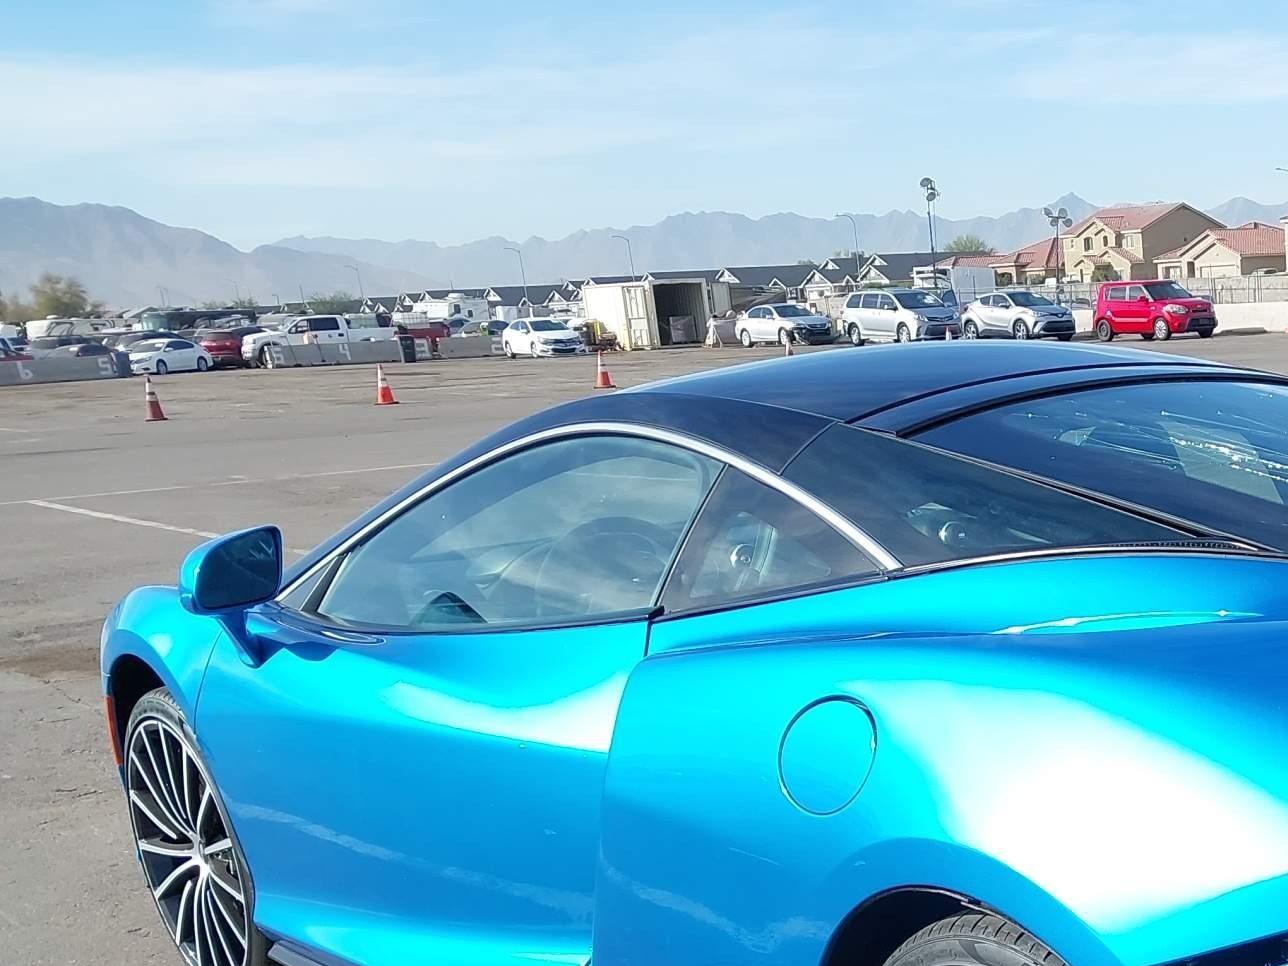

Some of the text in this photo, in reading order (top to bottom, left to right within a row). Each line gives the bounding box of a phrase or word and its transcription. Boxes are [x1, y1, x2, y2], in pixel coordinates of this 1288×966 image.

[339, 343, 352, 361] 4
[17, 361, 33, 380] 6
[97, 358, 113, 375] 5
